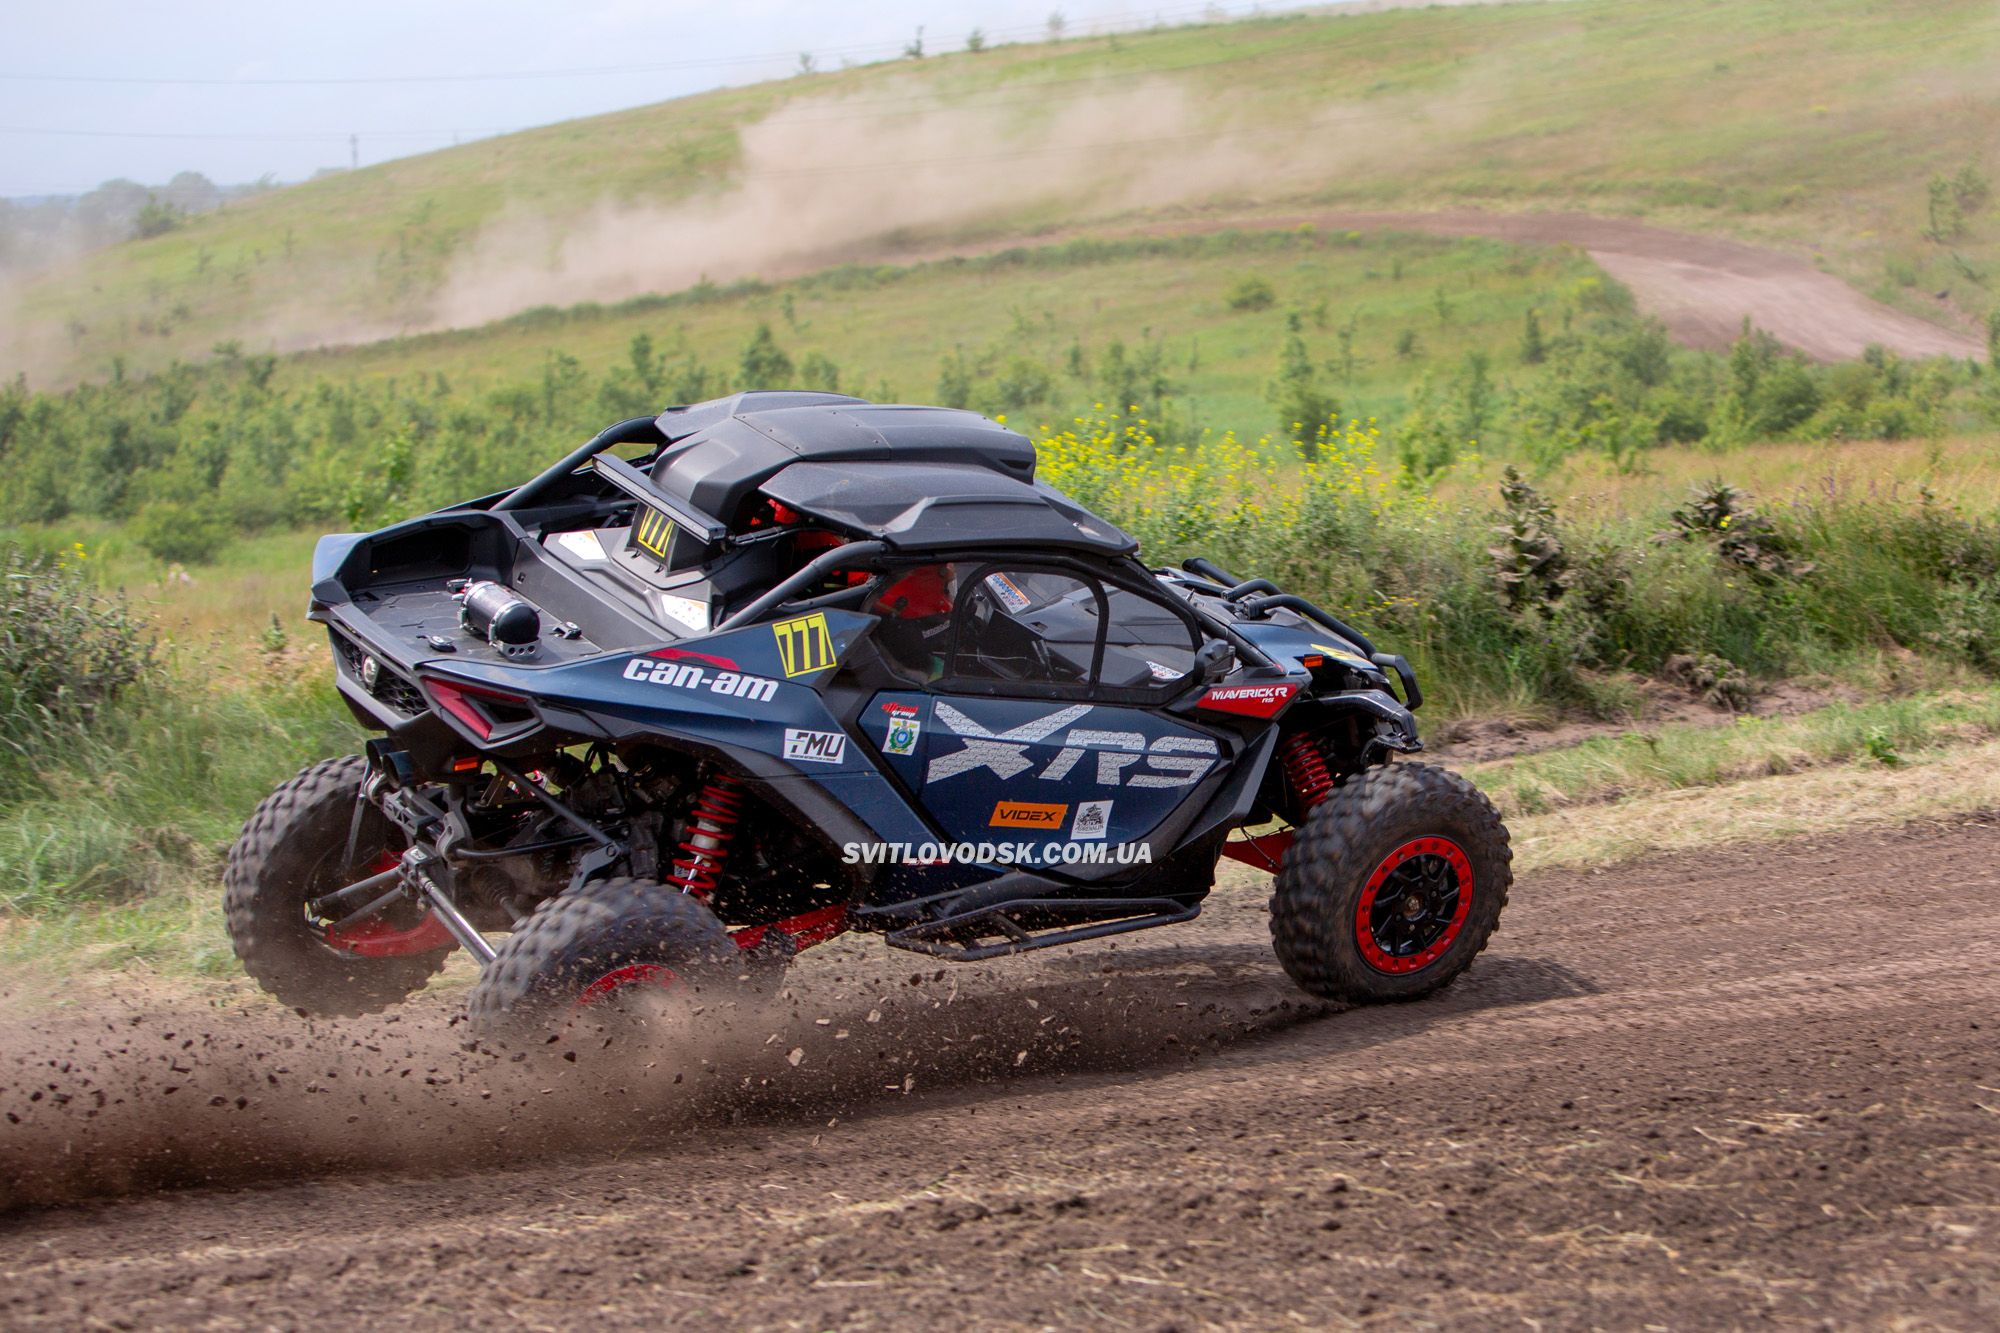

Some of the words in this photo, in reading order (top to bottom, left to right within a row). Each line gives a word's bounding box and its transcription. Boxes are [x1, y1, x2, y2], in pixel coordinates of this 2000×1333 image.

[775, 615, 830, 674] 777
[623, 658, 779, 702] can-am
[1211, 686, 1274, 700] MAVERICK
[1275, 687, 1288, 697] R
[790, 731, 845, 757] FMU
[1000, 809, 1056, 821] VIDEX
